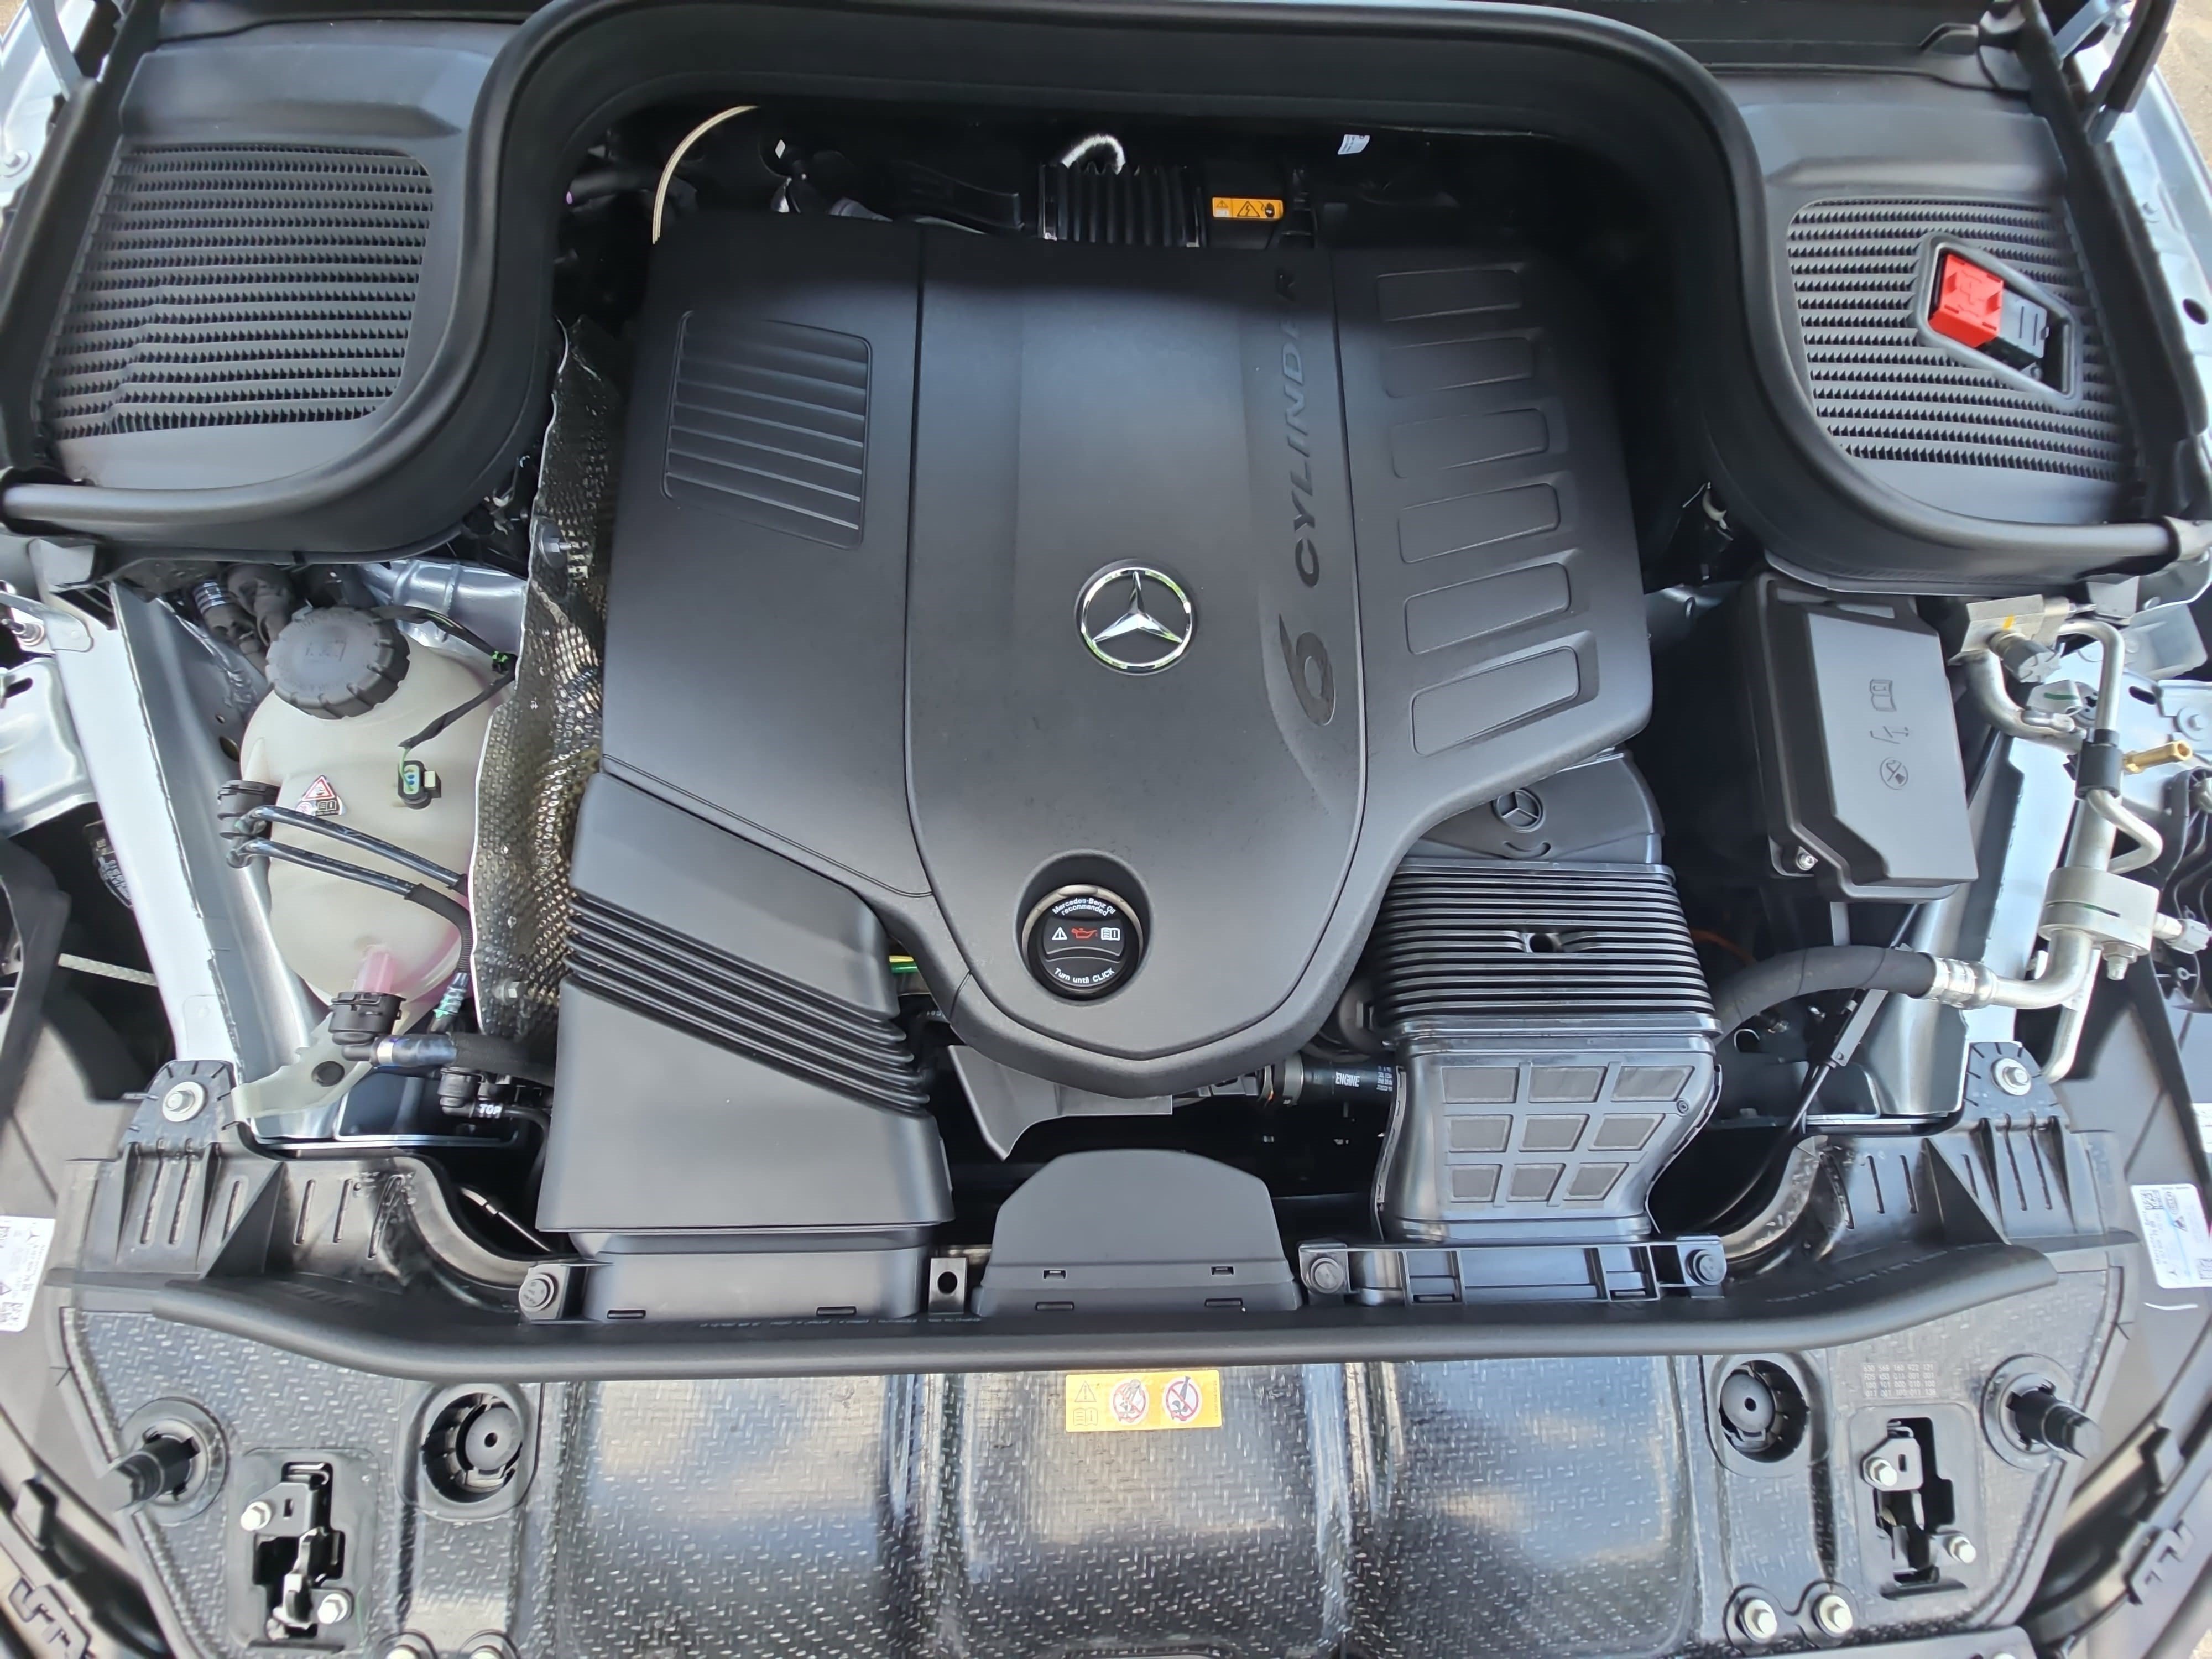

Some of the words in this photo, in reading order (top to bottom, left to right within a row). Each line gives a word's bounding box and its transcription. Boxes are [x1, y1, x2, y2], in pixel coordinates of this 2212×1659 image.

[1278, 613, 1337, 726] 6
[1052, 898, 1106, 914] Mercedes-Benz
[1107, 905, 1116, 915] Oil
[1061, 904, 1109, 916] recommended
[1054, 968, 1070, 981] Turn
[1092, 968, 1115, 983] CLICK
[1335, 1071, 1360, 1088] ENGINE
[479, 1103, 502, 1114] TOP
